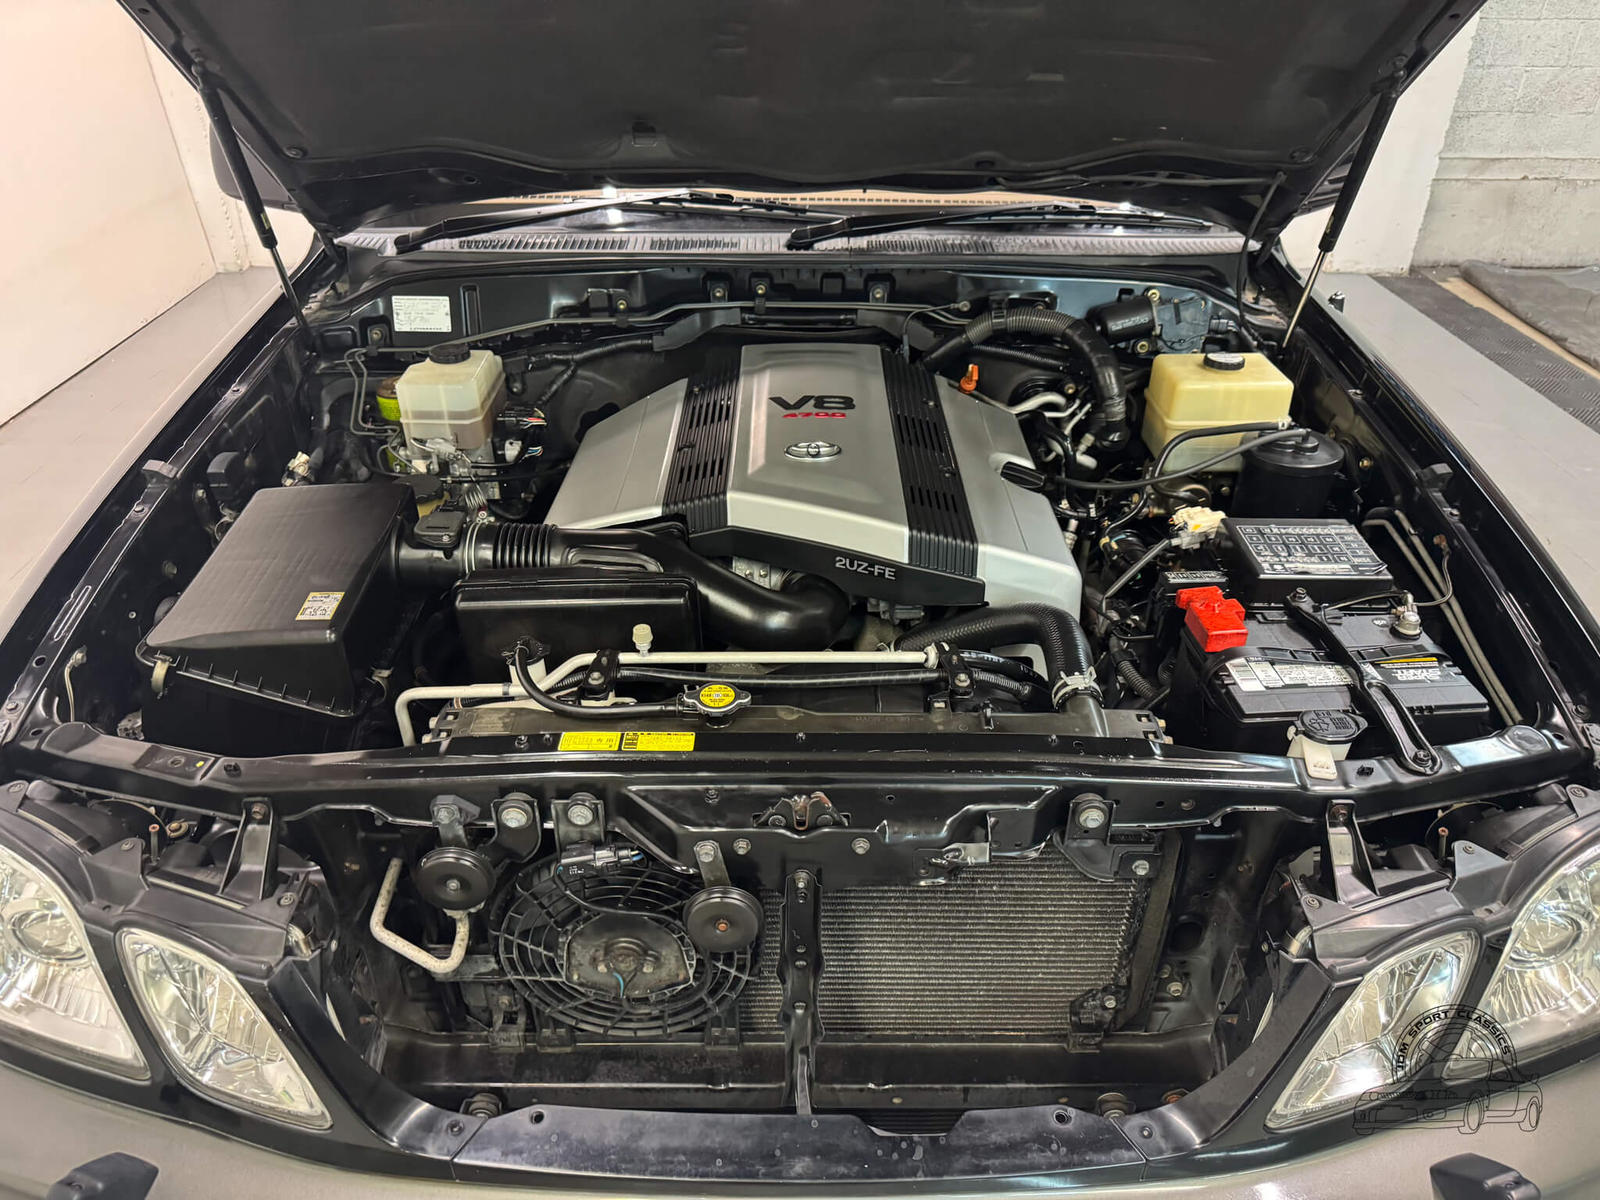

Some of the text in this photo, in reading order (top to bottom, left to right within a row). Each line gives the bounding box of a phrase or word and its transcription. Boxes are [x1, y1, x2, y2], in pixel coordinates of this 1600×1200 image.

[768, 395, 856, 411] V8
[782, 411, 847, 419] 4700
[835, 556, 896, 580] 2UZ-FE
